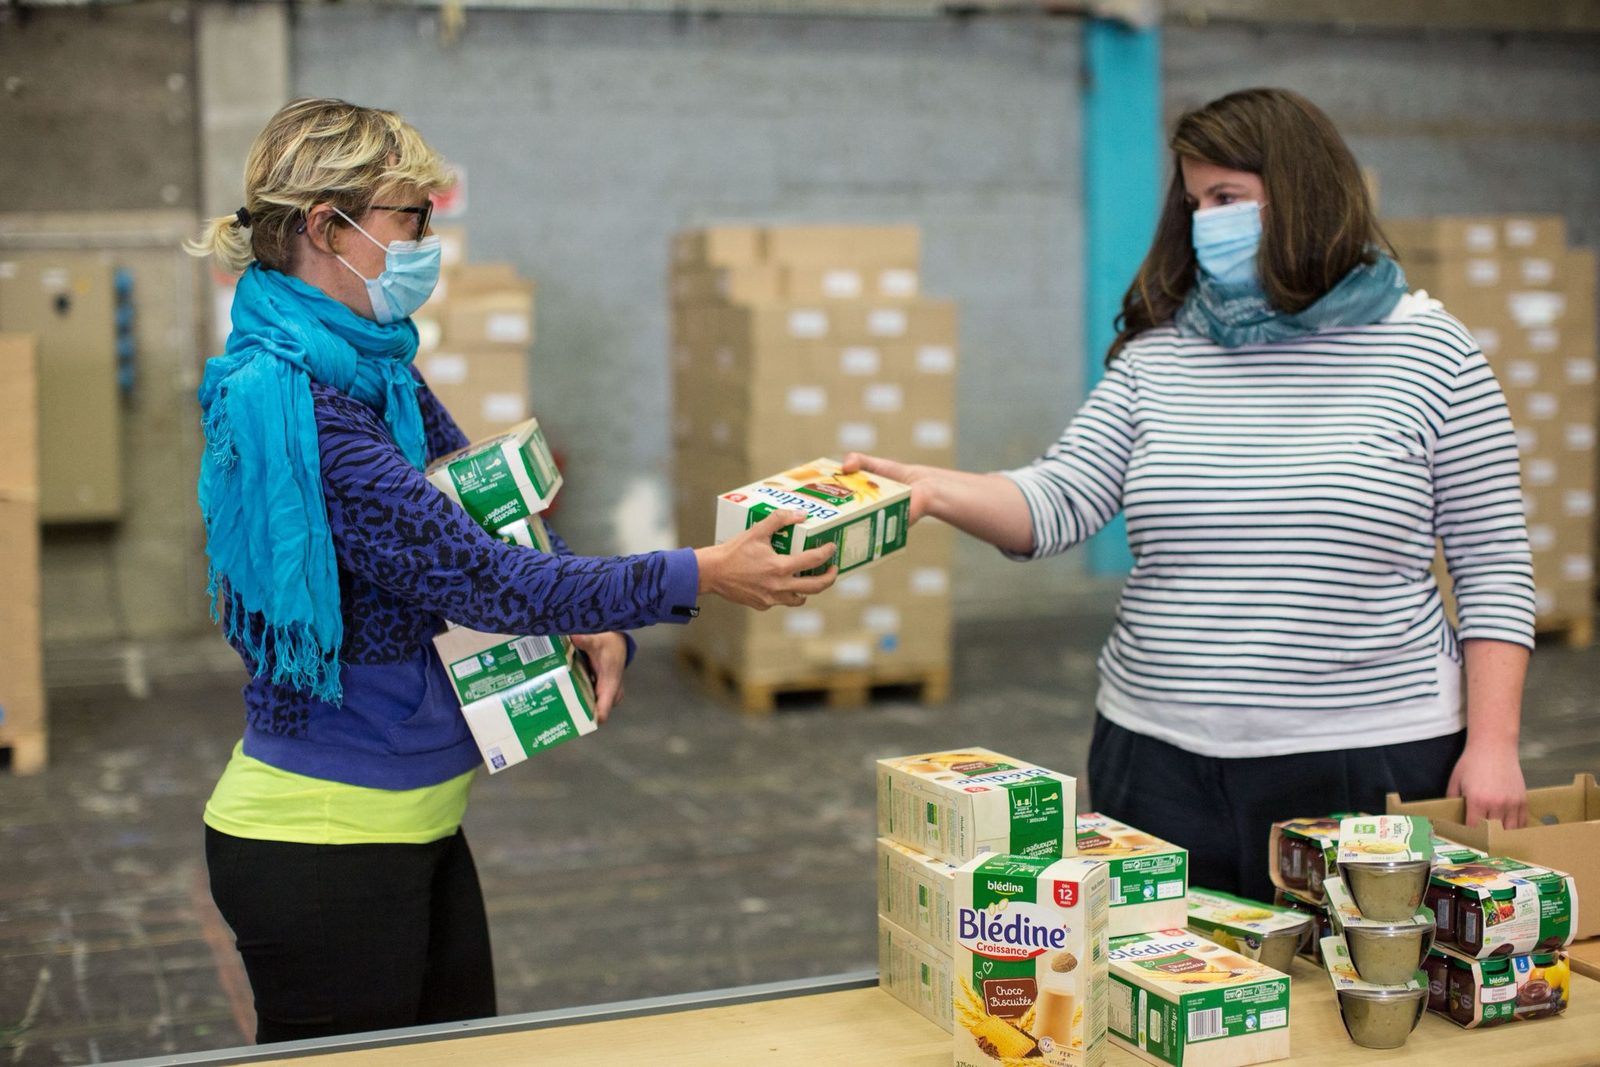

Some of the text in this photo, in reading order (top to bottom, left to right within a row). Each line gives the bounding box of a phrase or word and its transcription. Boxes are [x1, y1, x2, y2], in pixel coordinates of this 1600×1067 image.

[987, 880, 1024, 893] blédina
[1058, 889, 1073, 900] 12
[959, 908, 1066, 949] Blédine
[976, 941, 1028, 956] Croissance
[996, 985, 1025, 996] Choco
[990, 996, 1034, 1007] Biscuitée
